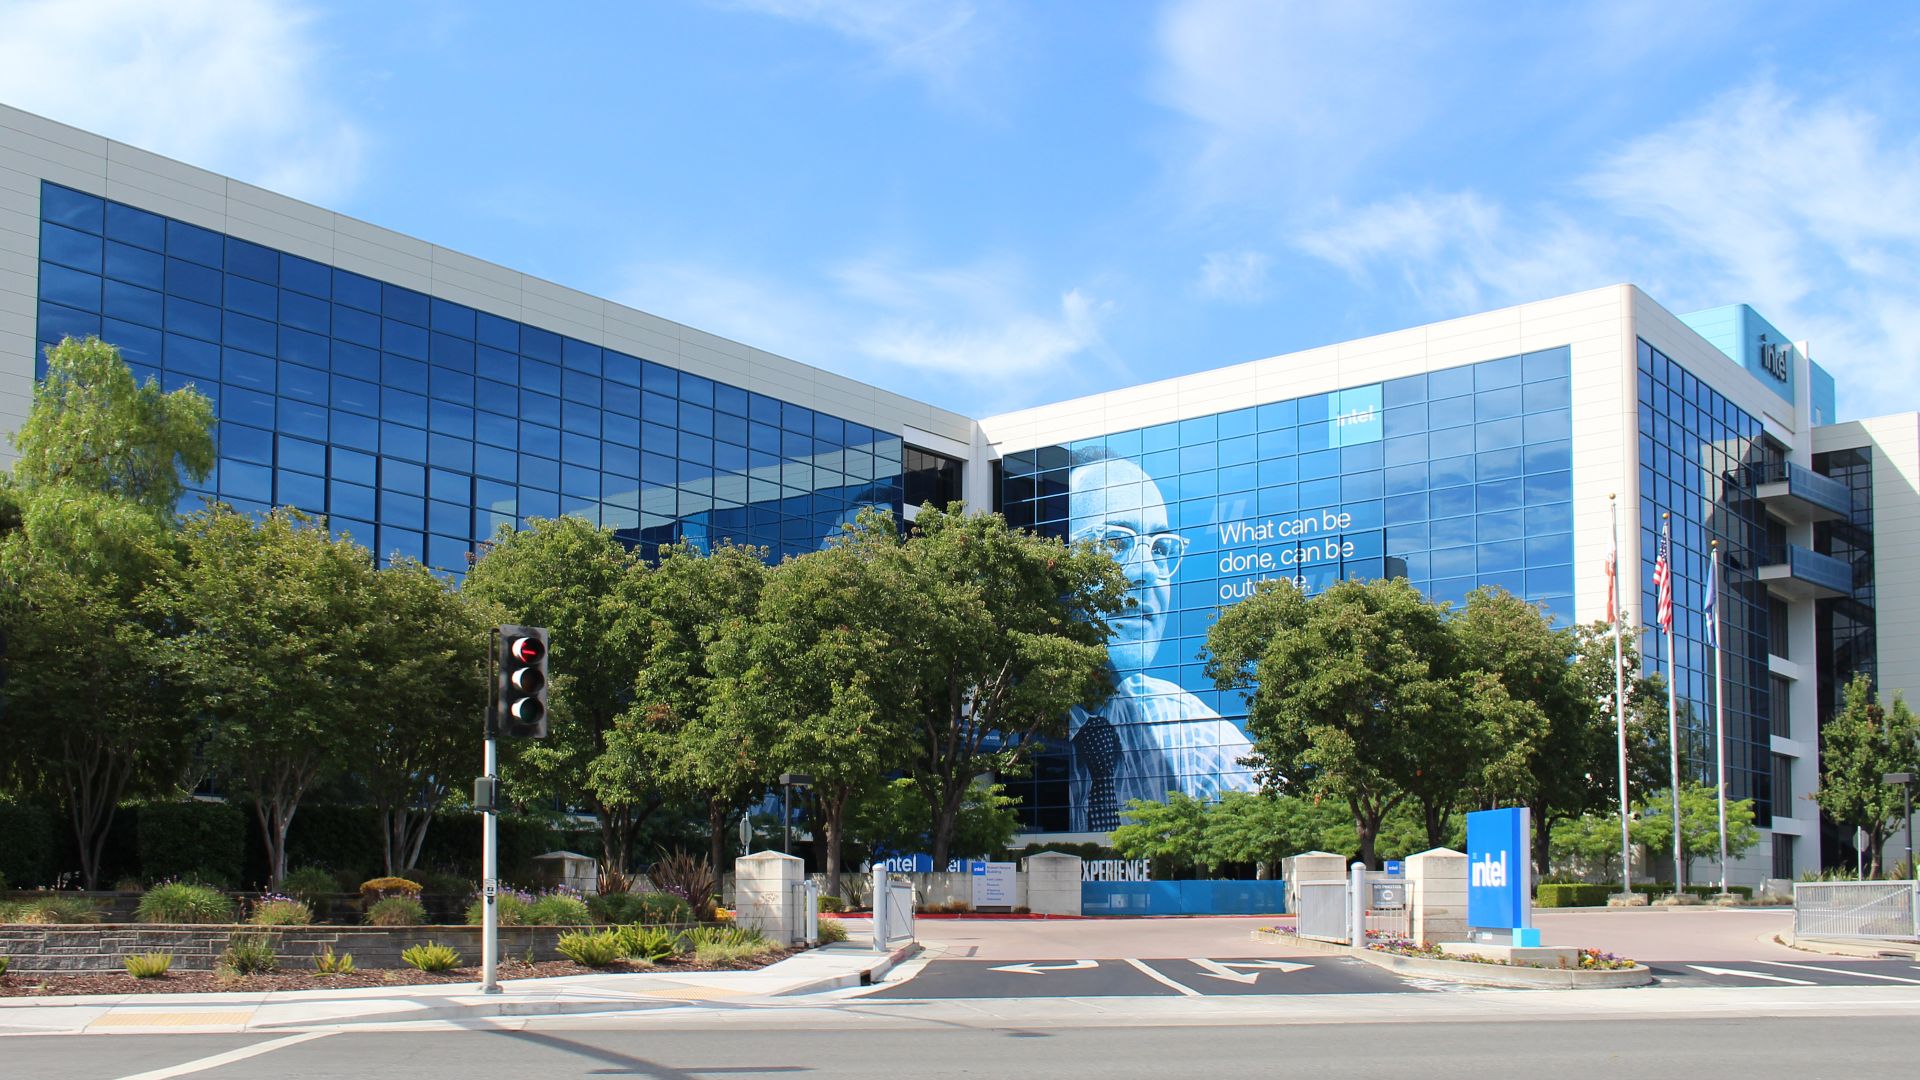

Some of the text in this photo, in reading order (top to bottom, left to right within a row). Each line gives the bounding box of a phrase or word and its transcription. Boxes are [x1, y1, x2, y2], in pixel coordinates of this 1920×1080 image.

[1760, 334, 1787, 383] intel
[1220, 509, 1351, 545] What can be
[1220, 538, 1355, 573] done, can be
[882, 854, 917, 872] ntel
[1081, 859, 1151, 882] XPERIENCE
[1471, 850, 1507, 887] intel
